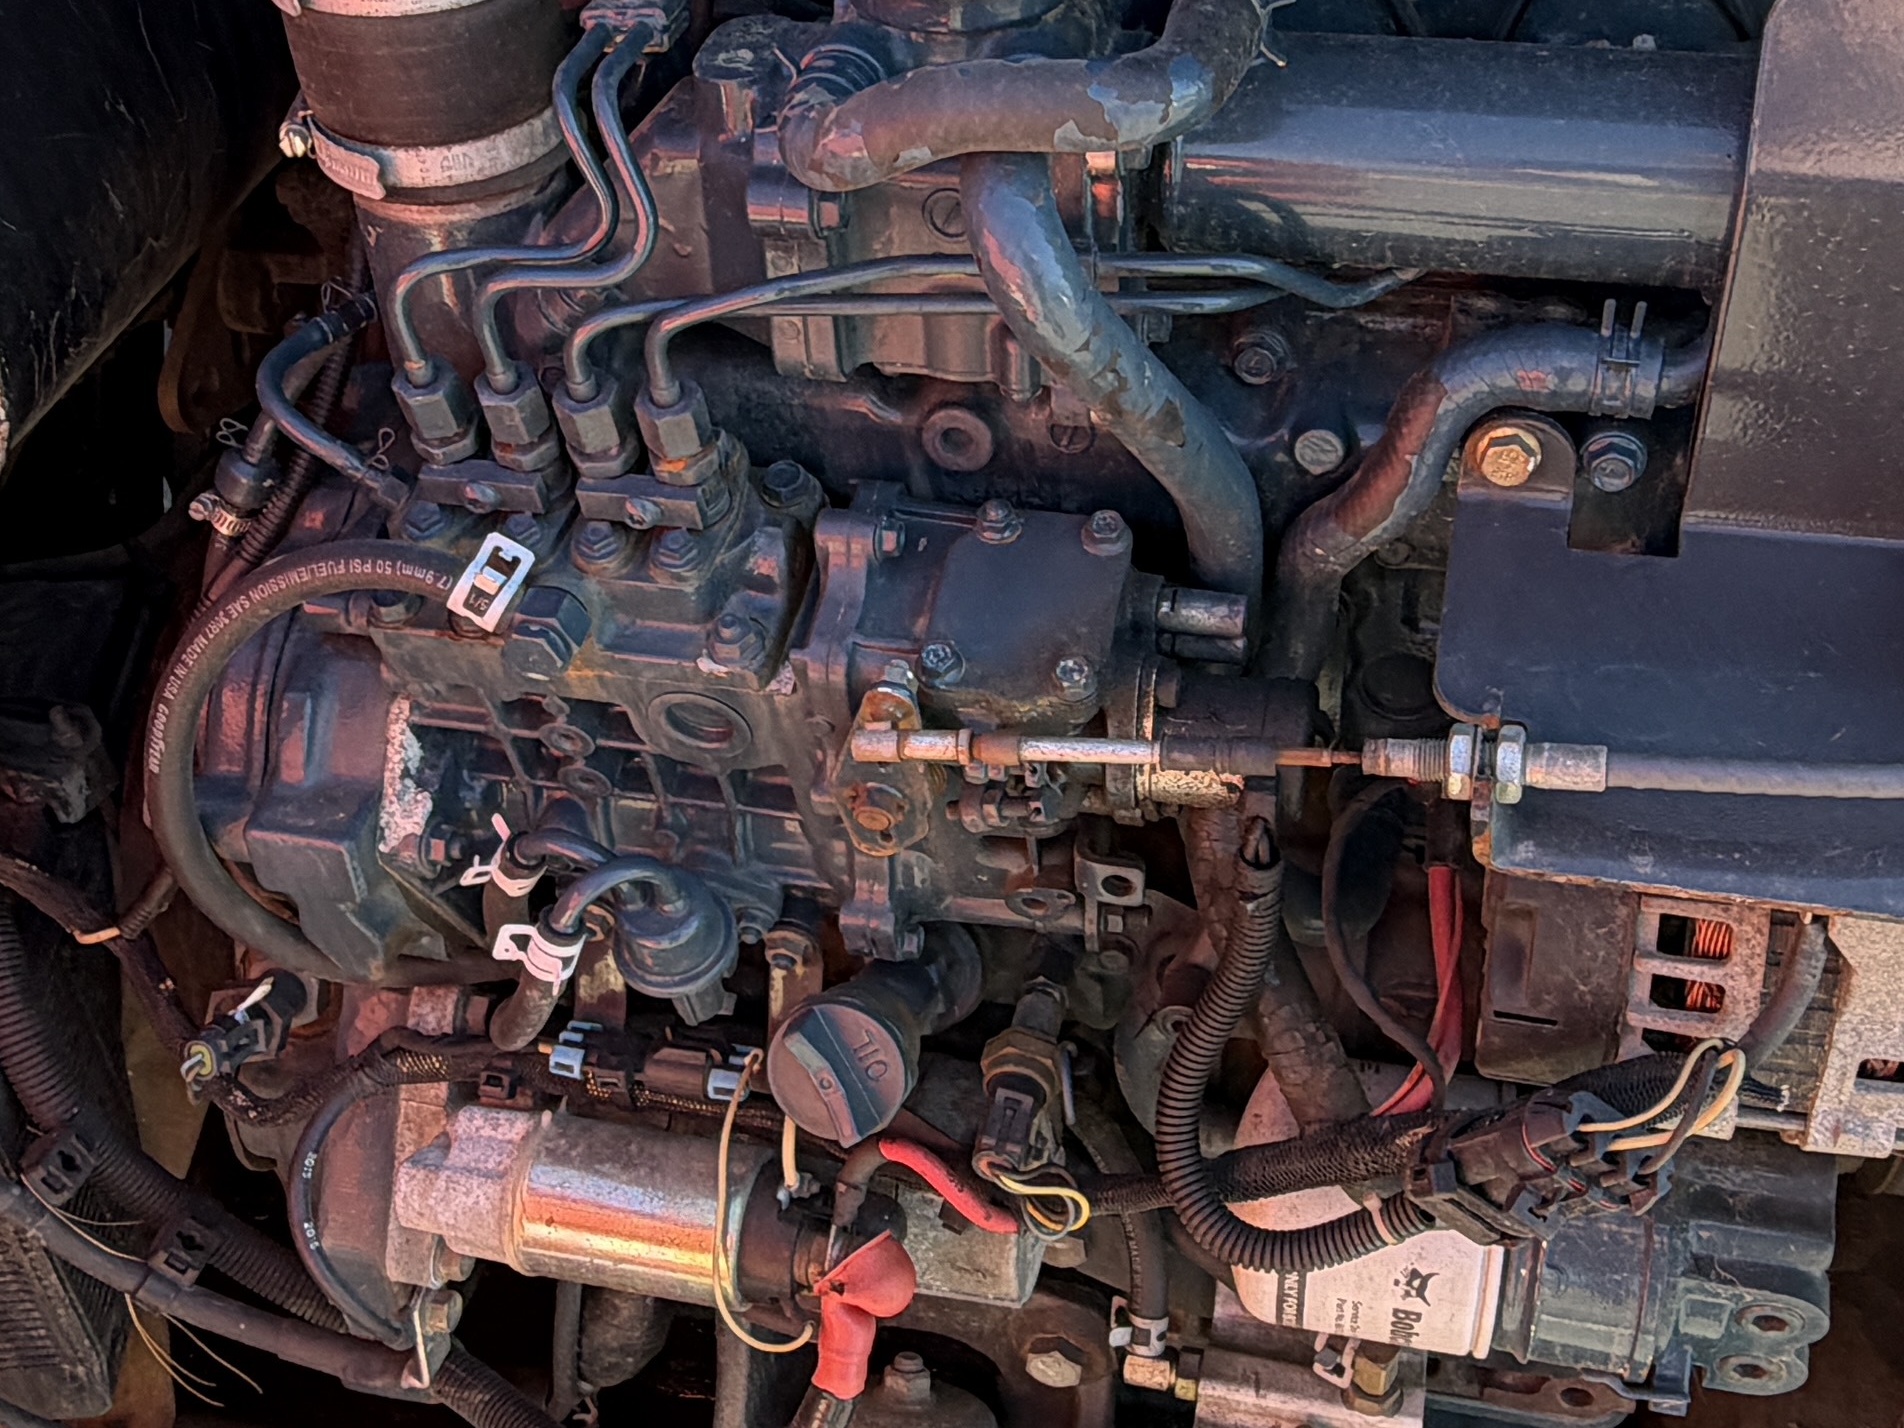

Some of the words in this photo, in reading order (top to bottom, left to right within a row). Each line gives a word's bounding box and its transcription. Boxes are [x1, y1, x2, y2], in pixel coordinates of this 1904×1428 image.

[249, 558, 346, 598] FUEL/EMISSION
[345, 557, 373, 574] PSI
[375, 559, 393, 575] 50
[395, 560, 455, 591] (7.9mm)
[226, 594, 252, 621] SAE
[469, 593, 490, 612] 5/1
[181, 632, 209, 667] MADE
[161, 673, 182, 701] USA
[852, 1028, 888, 1083] OIL
